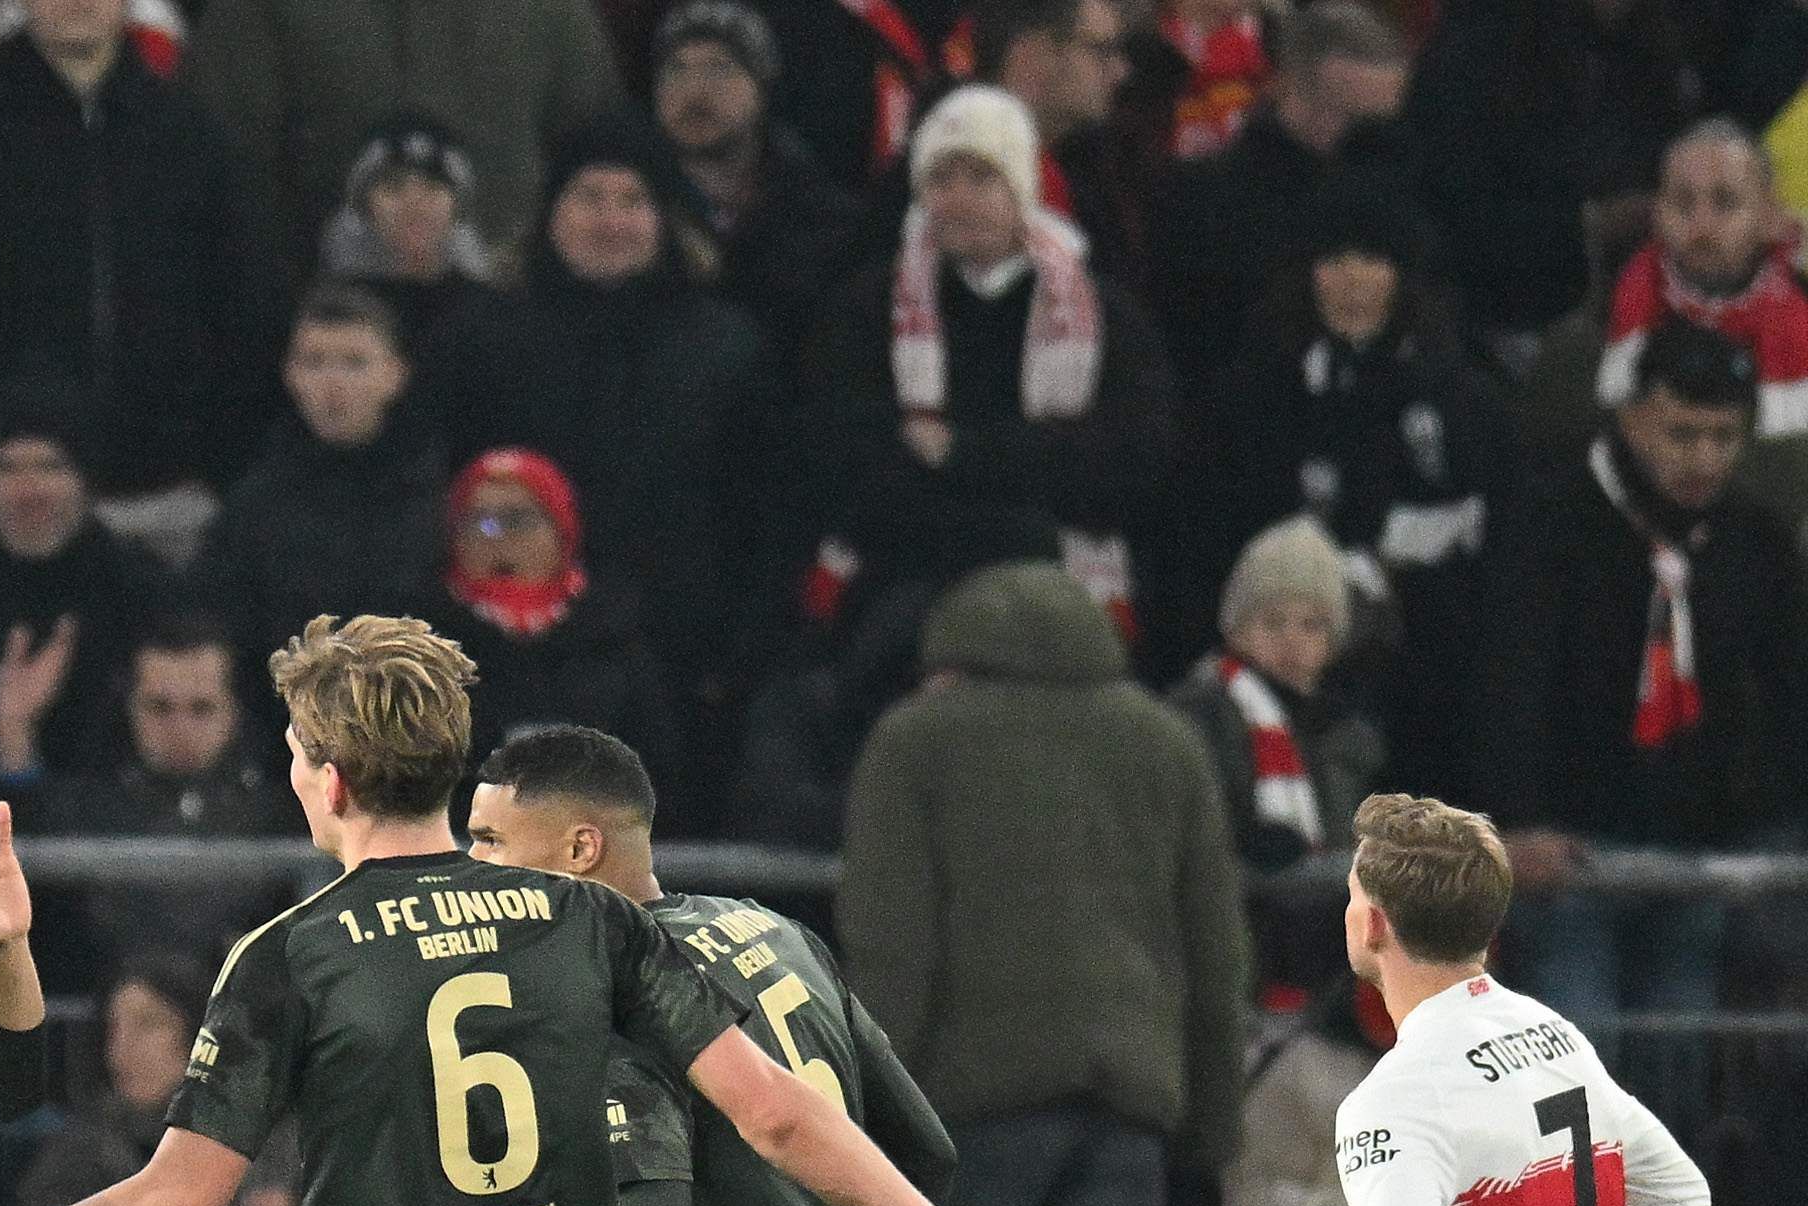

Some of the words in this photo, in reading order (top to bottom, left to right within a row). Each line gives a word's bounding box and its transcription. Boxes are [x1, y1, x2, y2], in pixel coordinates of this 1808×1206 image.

[338, 909, 376, 944] 1.
[376, 896, 429, 937] FC
[431, 887, 553, 927] UNION
[417, 926, 499, 960] BERLIN
[683, 926, 732, 963] FC
[1465, 1019, 1580, 1083] STUTTGAR
[427, 971, 539, 1195] 6
[1345, 1147, 1401, 1175] olar
